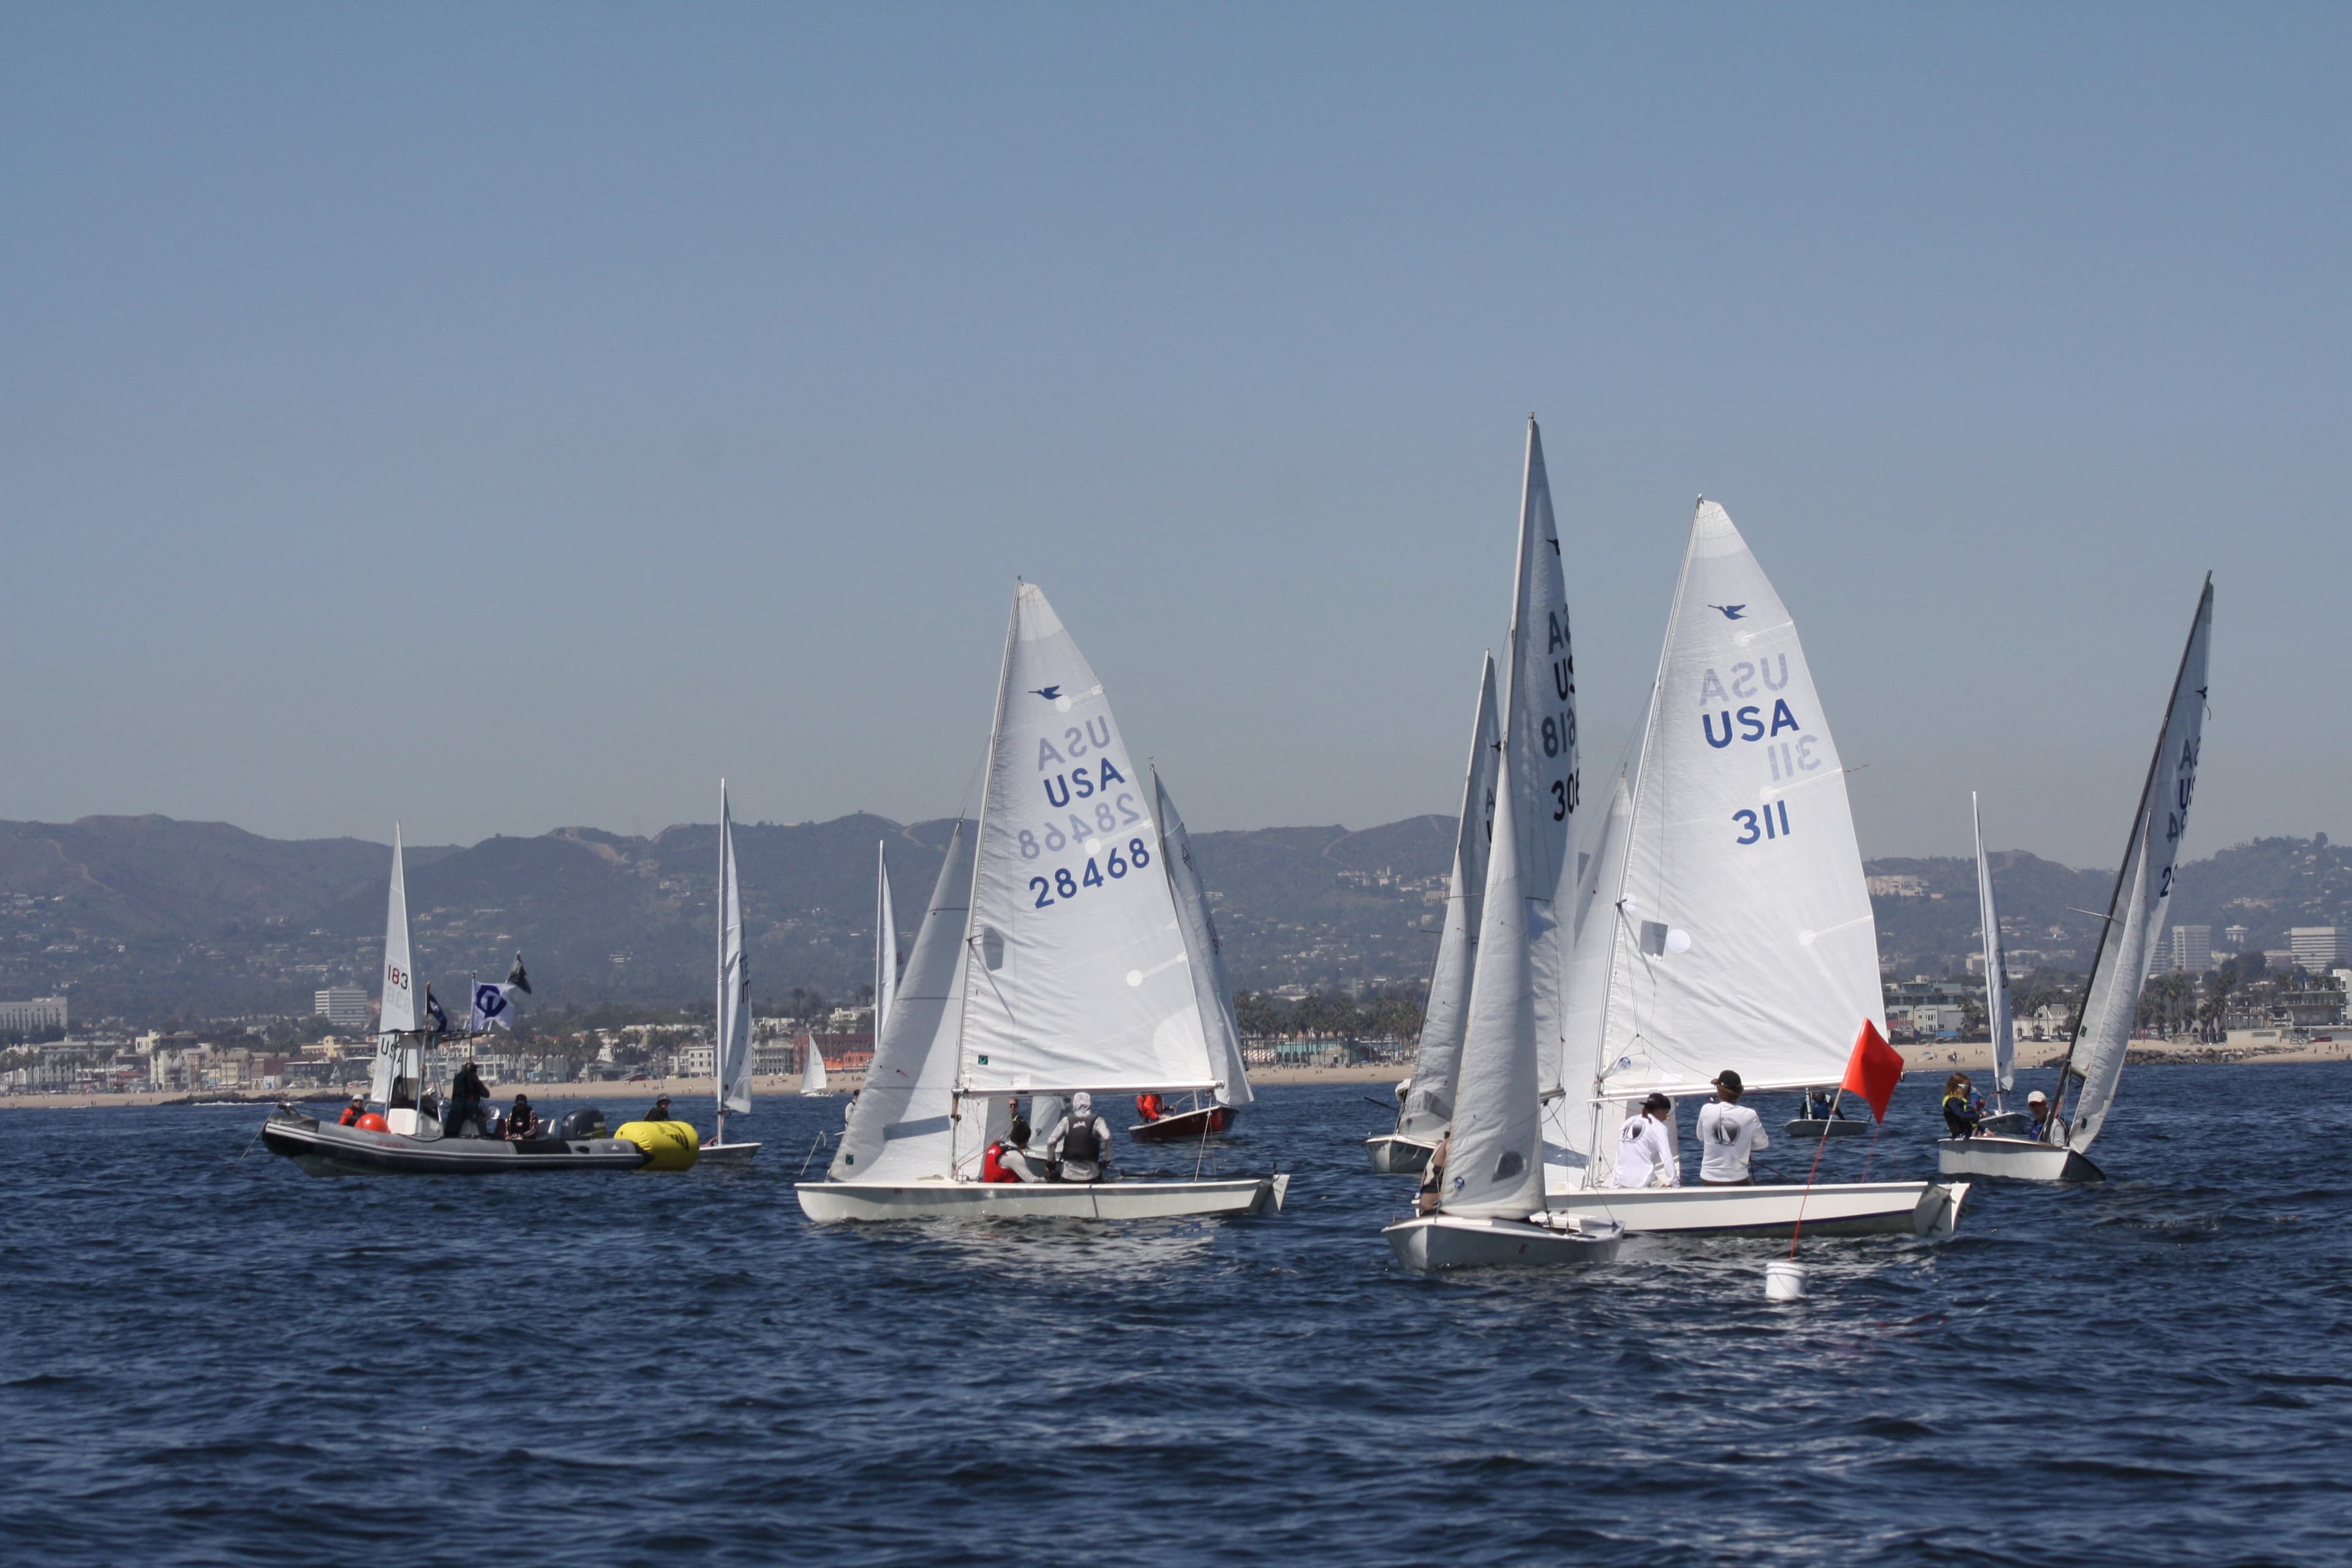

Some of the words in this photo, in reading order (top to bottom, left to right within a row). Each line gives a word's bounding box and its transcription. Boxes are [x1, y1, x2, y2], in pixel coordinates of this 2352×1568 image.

[1702, 698, 1800, 748] USA
[1044, 758, 1125, 807] USA
[1732, 800, 1790, 845] 311
[1029, 838, 1150, 909] 28468
